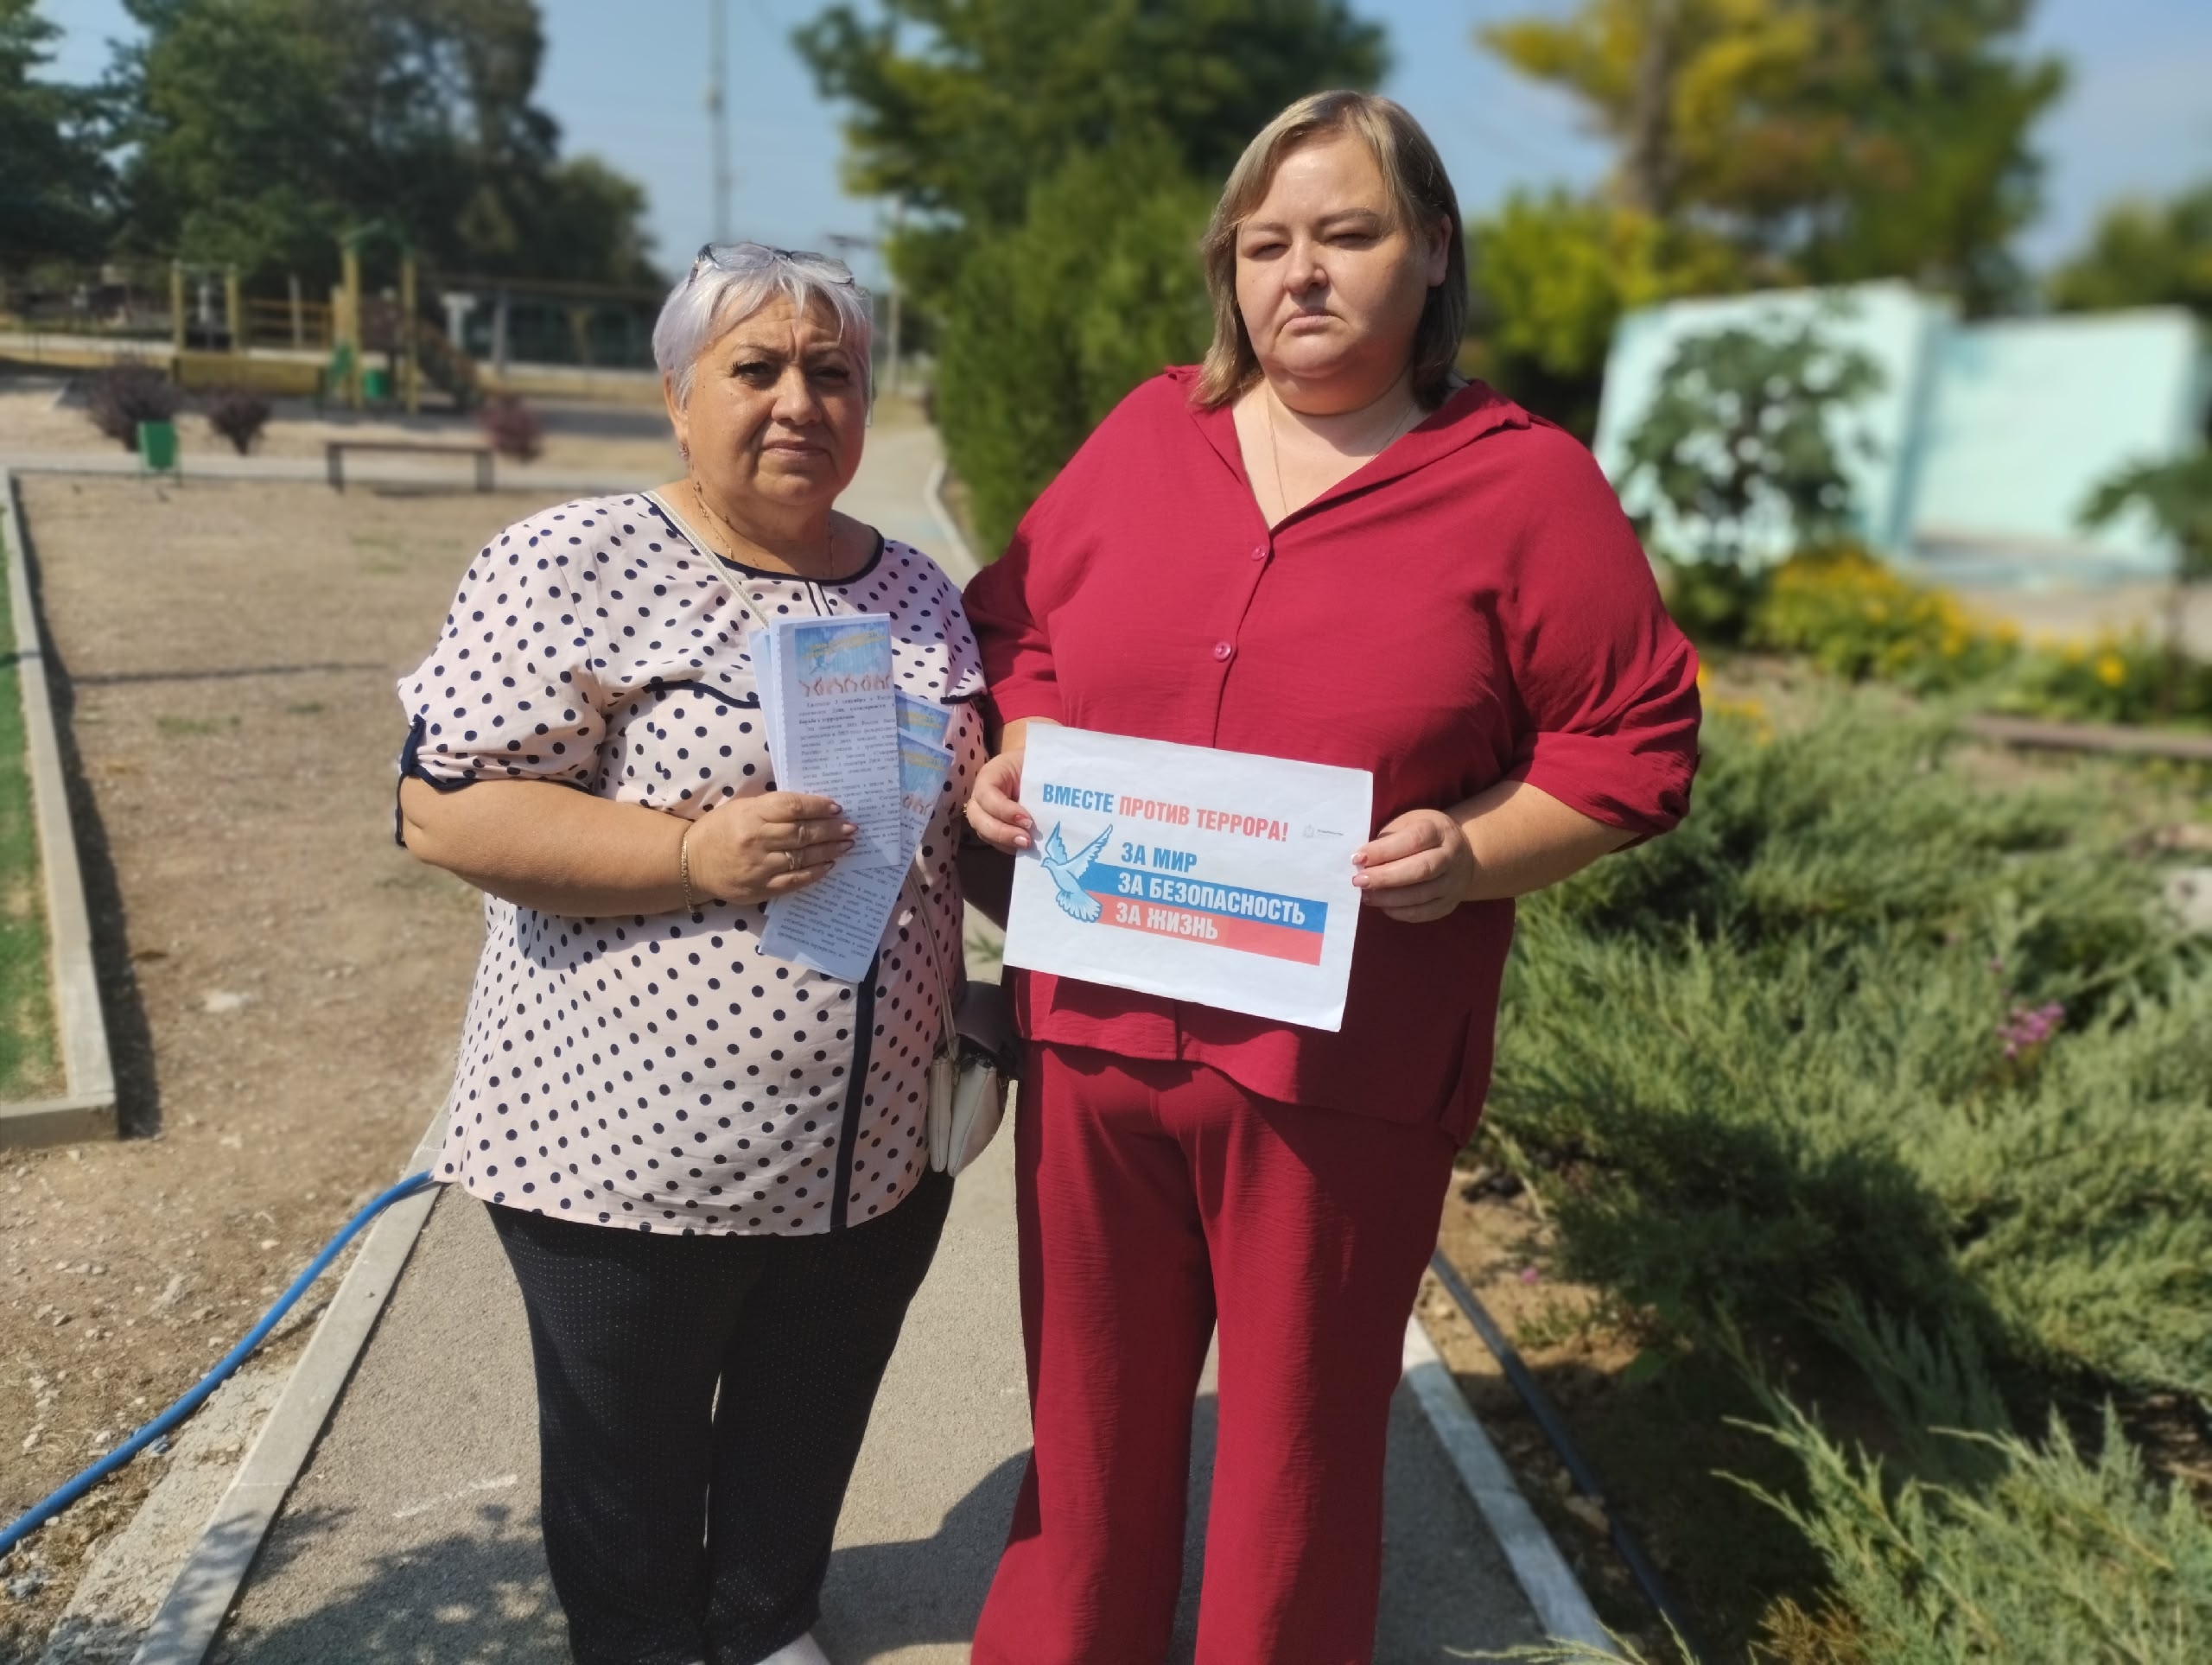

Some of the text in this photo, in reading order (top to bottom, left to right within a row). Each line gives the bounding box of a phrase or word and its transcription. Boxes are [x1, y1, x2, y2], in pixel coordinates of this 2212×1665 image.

[1043, 784, 1289, 842] ВМЕСТЕ ПРОТИВ ТЕРРОРА!
[1122, 842, 1198, 873] ЗА МИР
[1116, 903, 1218, 939] ЗА ЖИЗНЬ
[1118, 873, 1306, 925] ЗА БЕЗОПАСНОСТЬ
